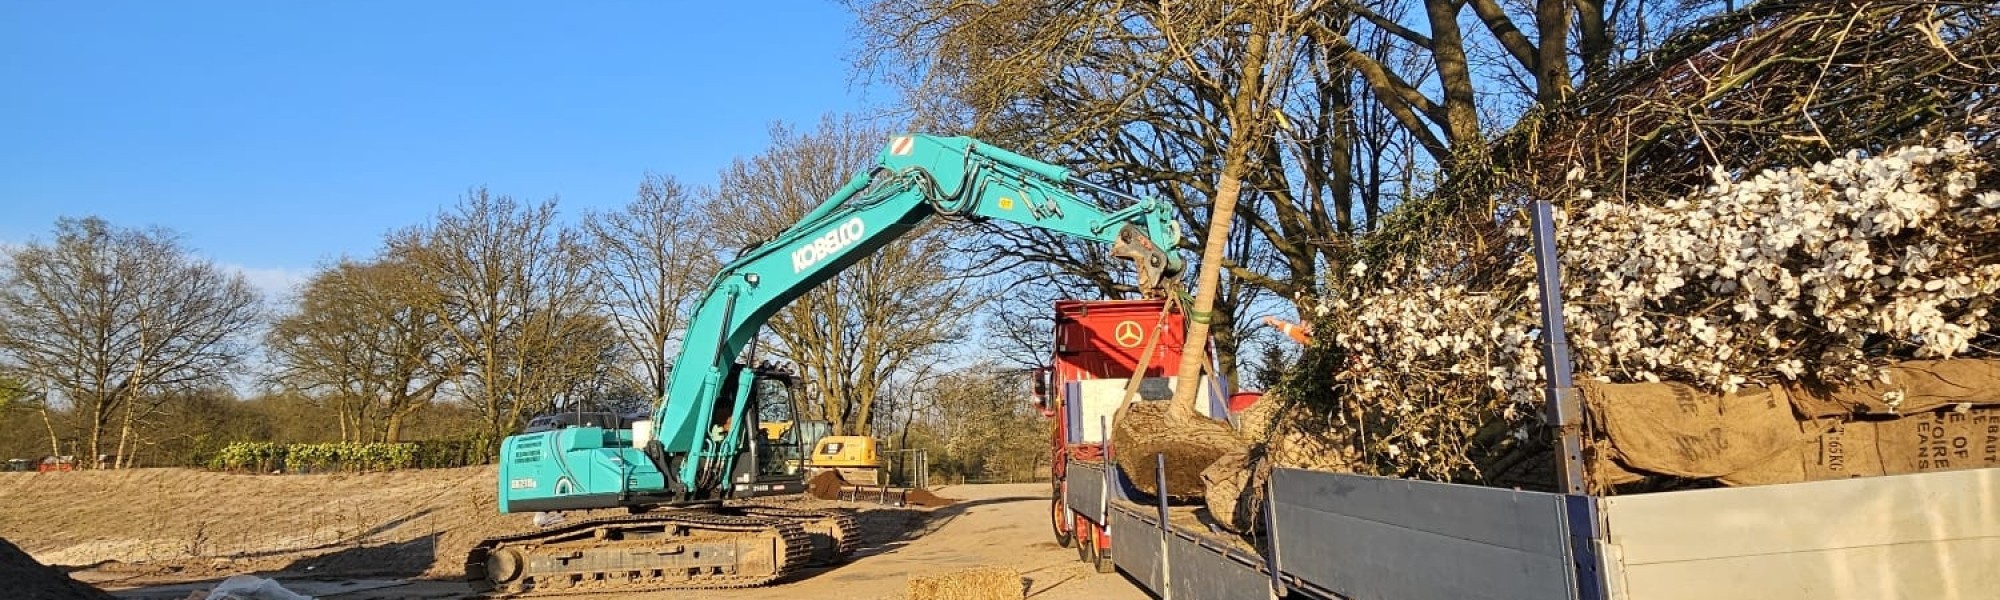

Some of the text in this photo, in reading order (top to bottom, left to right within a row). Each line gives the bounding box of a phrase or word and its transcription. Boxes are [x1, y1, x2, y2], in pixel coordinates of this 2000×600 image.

[791, 217, 865, 275] KOBELCO
[1917, 415, 1930, 469] EANS
[1952, 436, 1969, 458] OF
